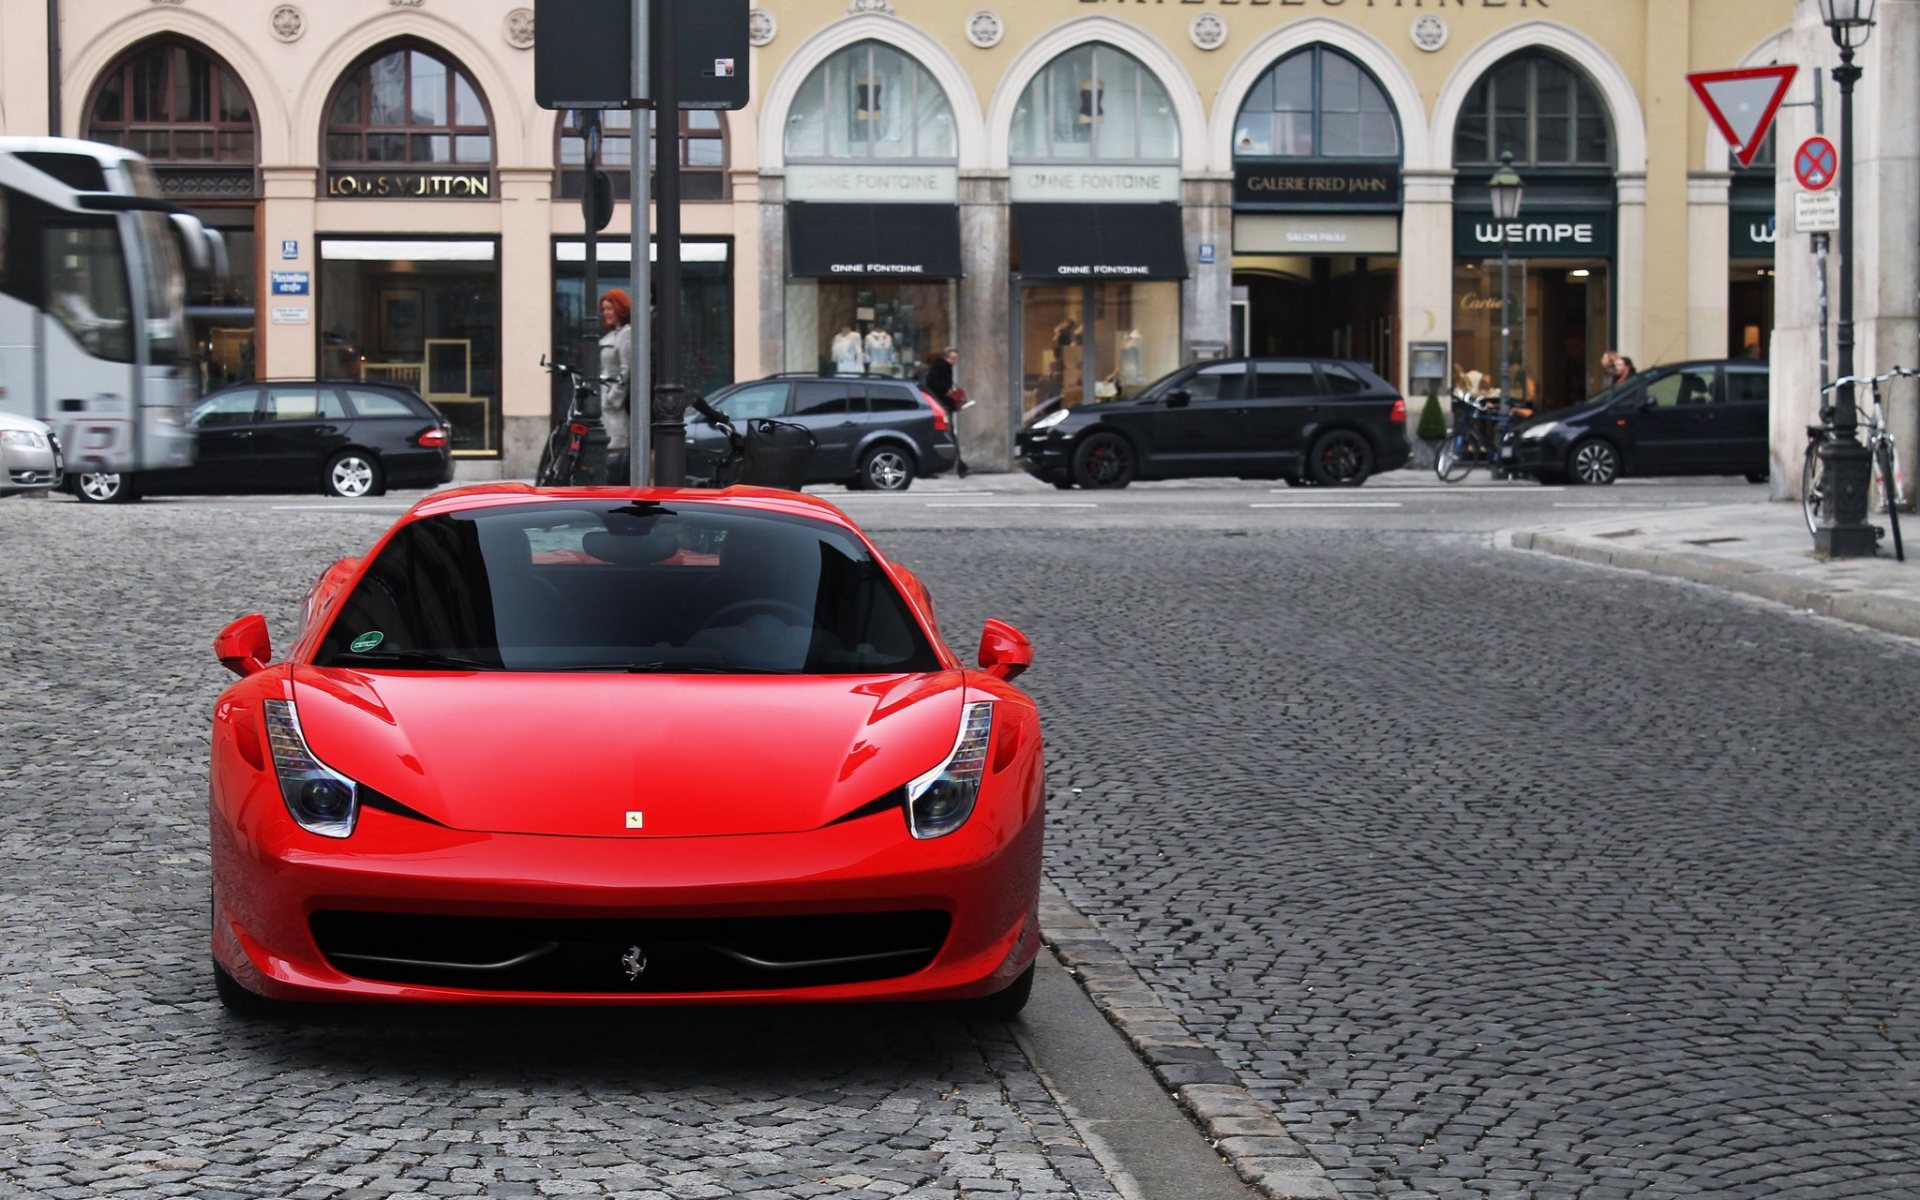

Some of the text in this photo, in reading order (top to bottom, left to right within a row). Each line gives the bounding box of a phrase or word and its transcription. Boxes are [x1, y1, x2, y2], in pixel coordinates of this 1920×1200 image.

[329, 175, 389, 195] LOUS
[1247, 176, 1388, 193] GALERIE FRED JAHN
[1475, 223, 1593, 242] WEMPE
[1460, 292, 1511, 309] Cartie
